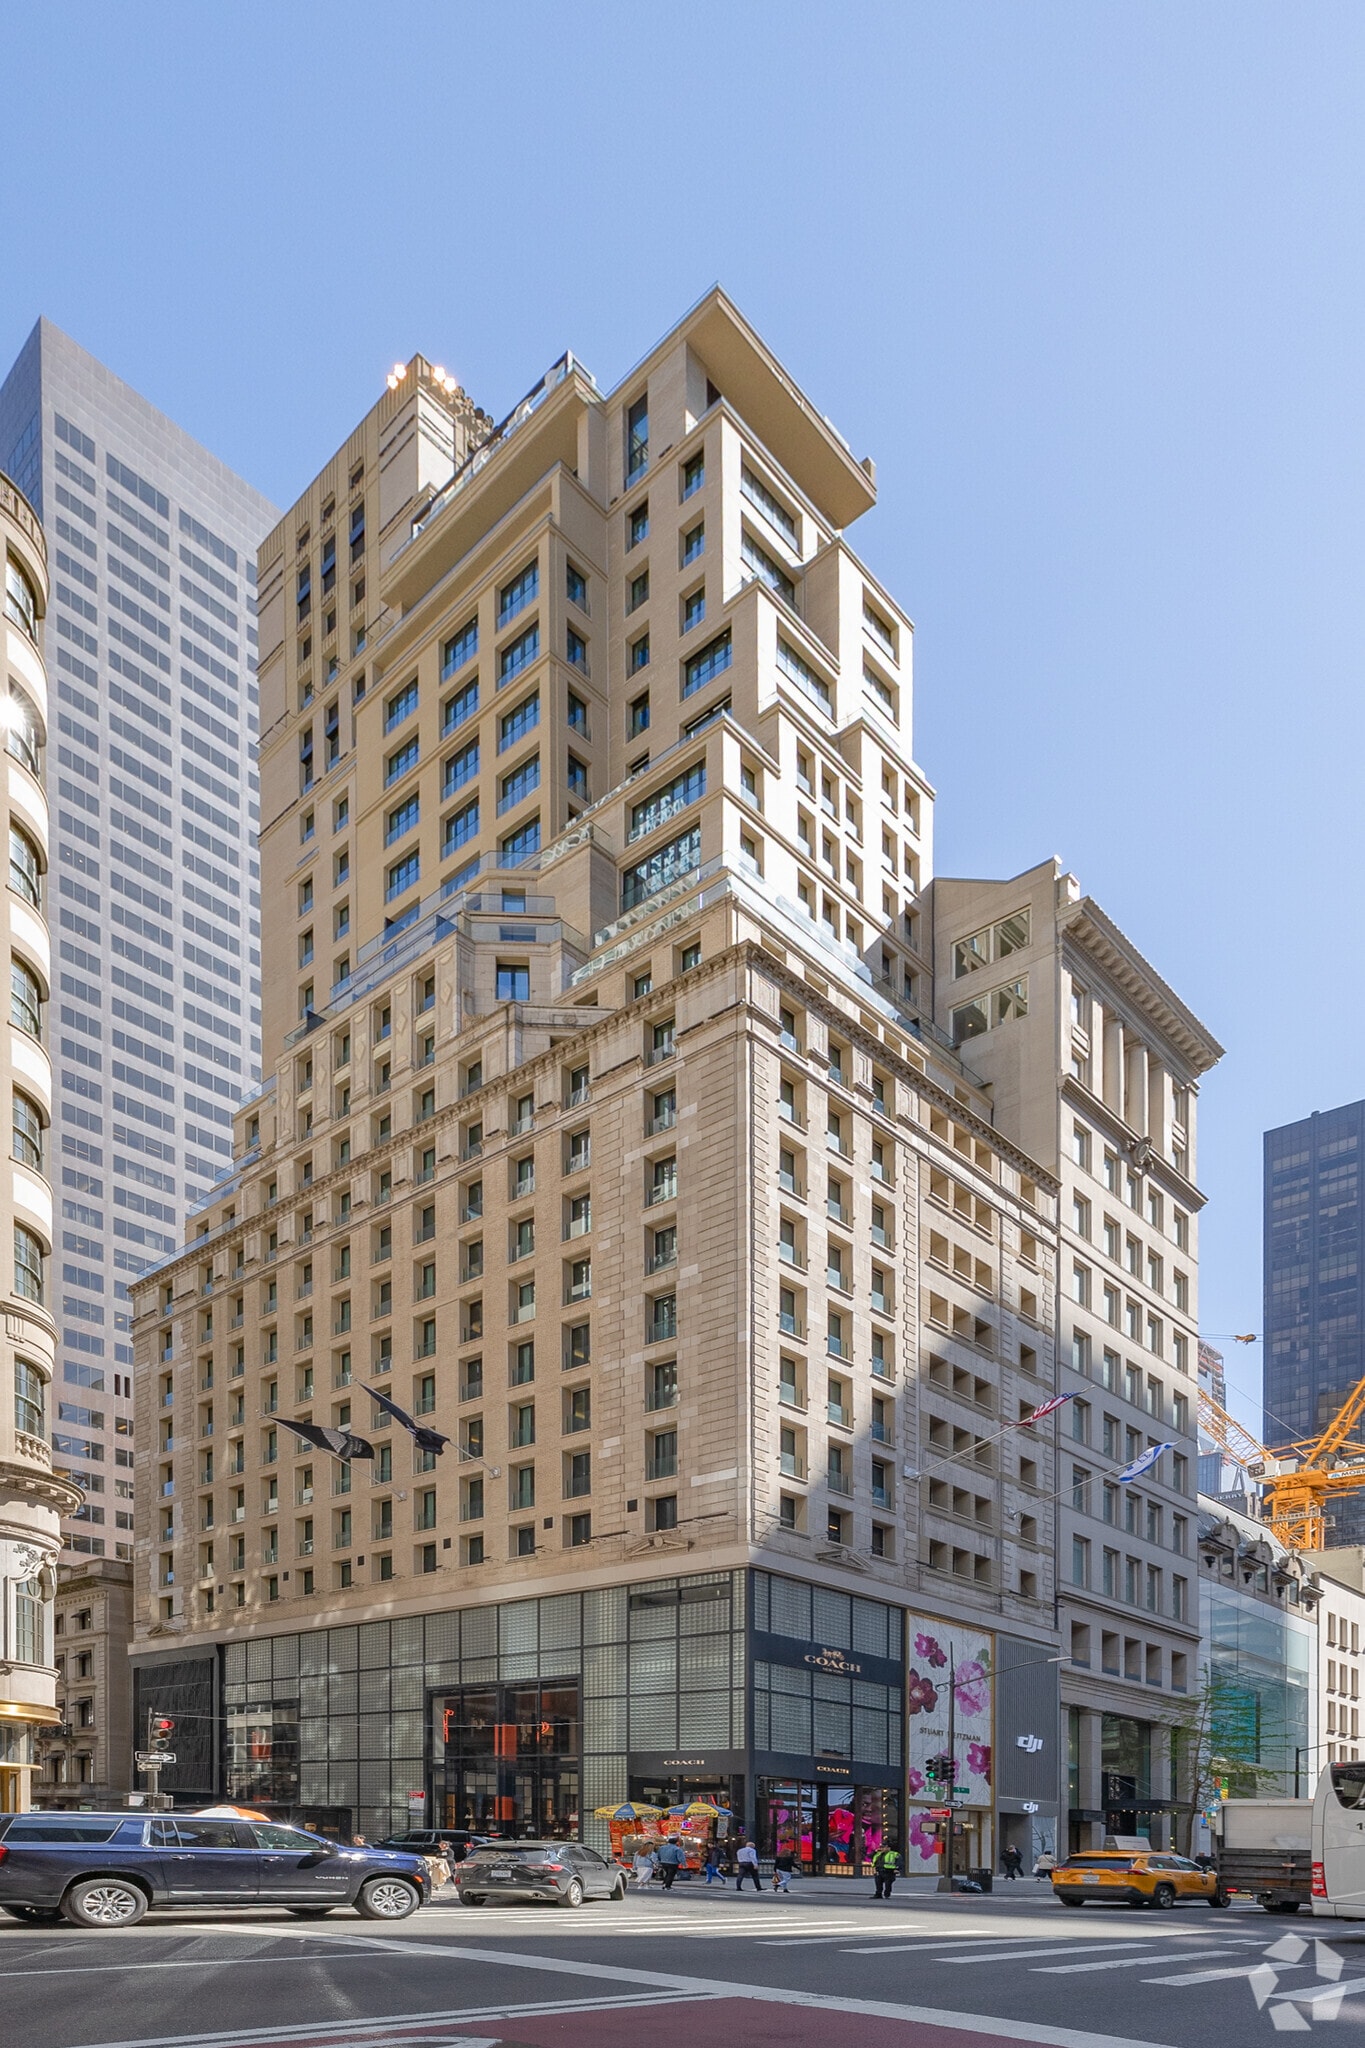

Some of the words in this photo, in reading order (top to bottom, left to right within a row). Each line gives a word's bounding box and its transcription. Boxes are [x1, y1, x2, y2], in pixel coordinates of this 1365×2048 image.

[804, 1654, 861, 1673] COACH
[919, 1726, 944, 1737] STUART
[948, 1731, 981, 1742] EITZMAN
[816, 1766, 849, 1774] COACH
